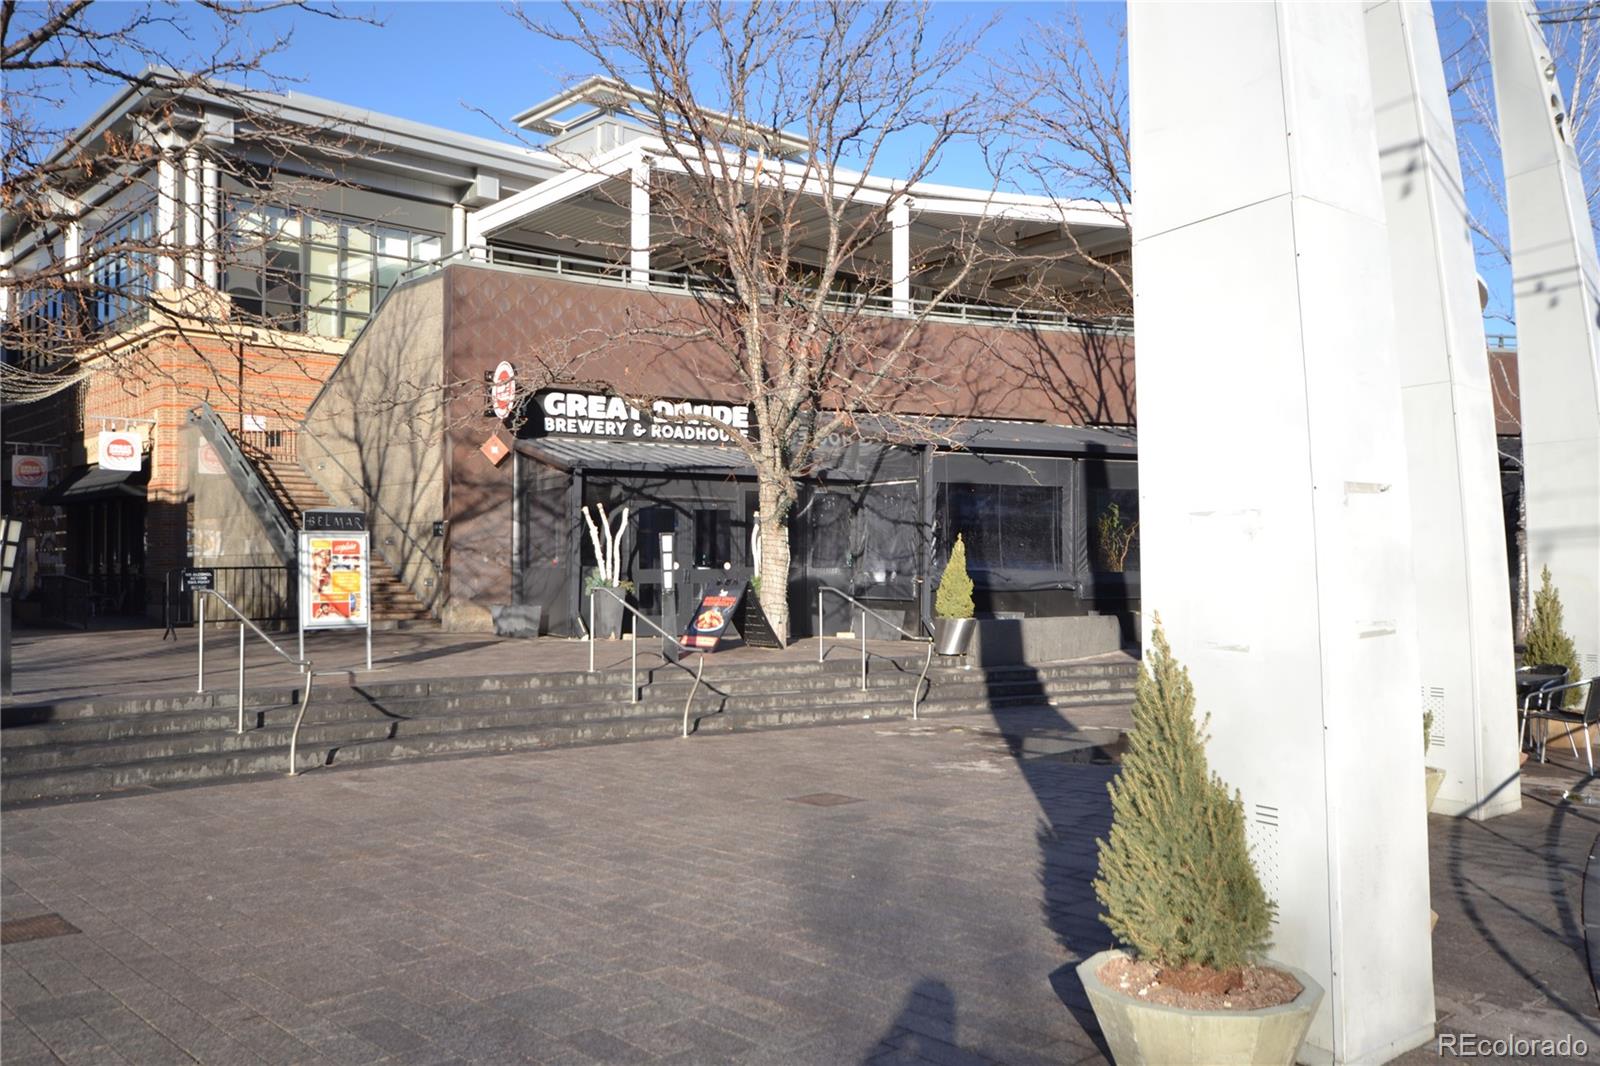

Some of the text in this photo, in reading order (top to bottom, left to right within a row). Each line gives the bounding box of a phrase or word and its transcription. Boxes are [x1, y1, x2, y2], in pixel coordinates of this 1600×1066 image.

[544, 392, 641, 421] GREAT
[653, 400, 749, 429] DIVIDE
[544, 417, 749, 443] BREWERY & ROADHOUE
[306, 514, 364, 530] BELMAR
